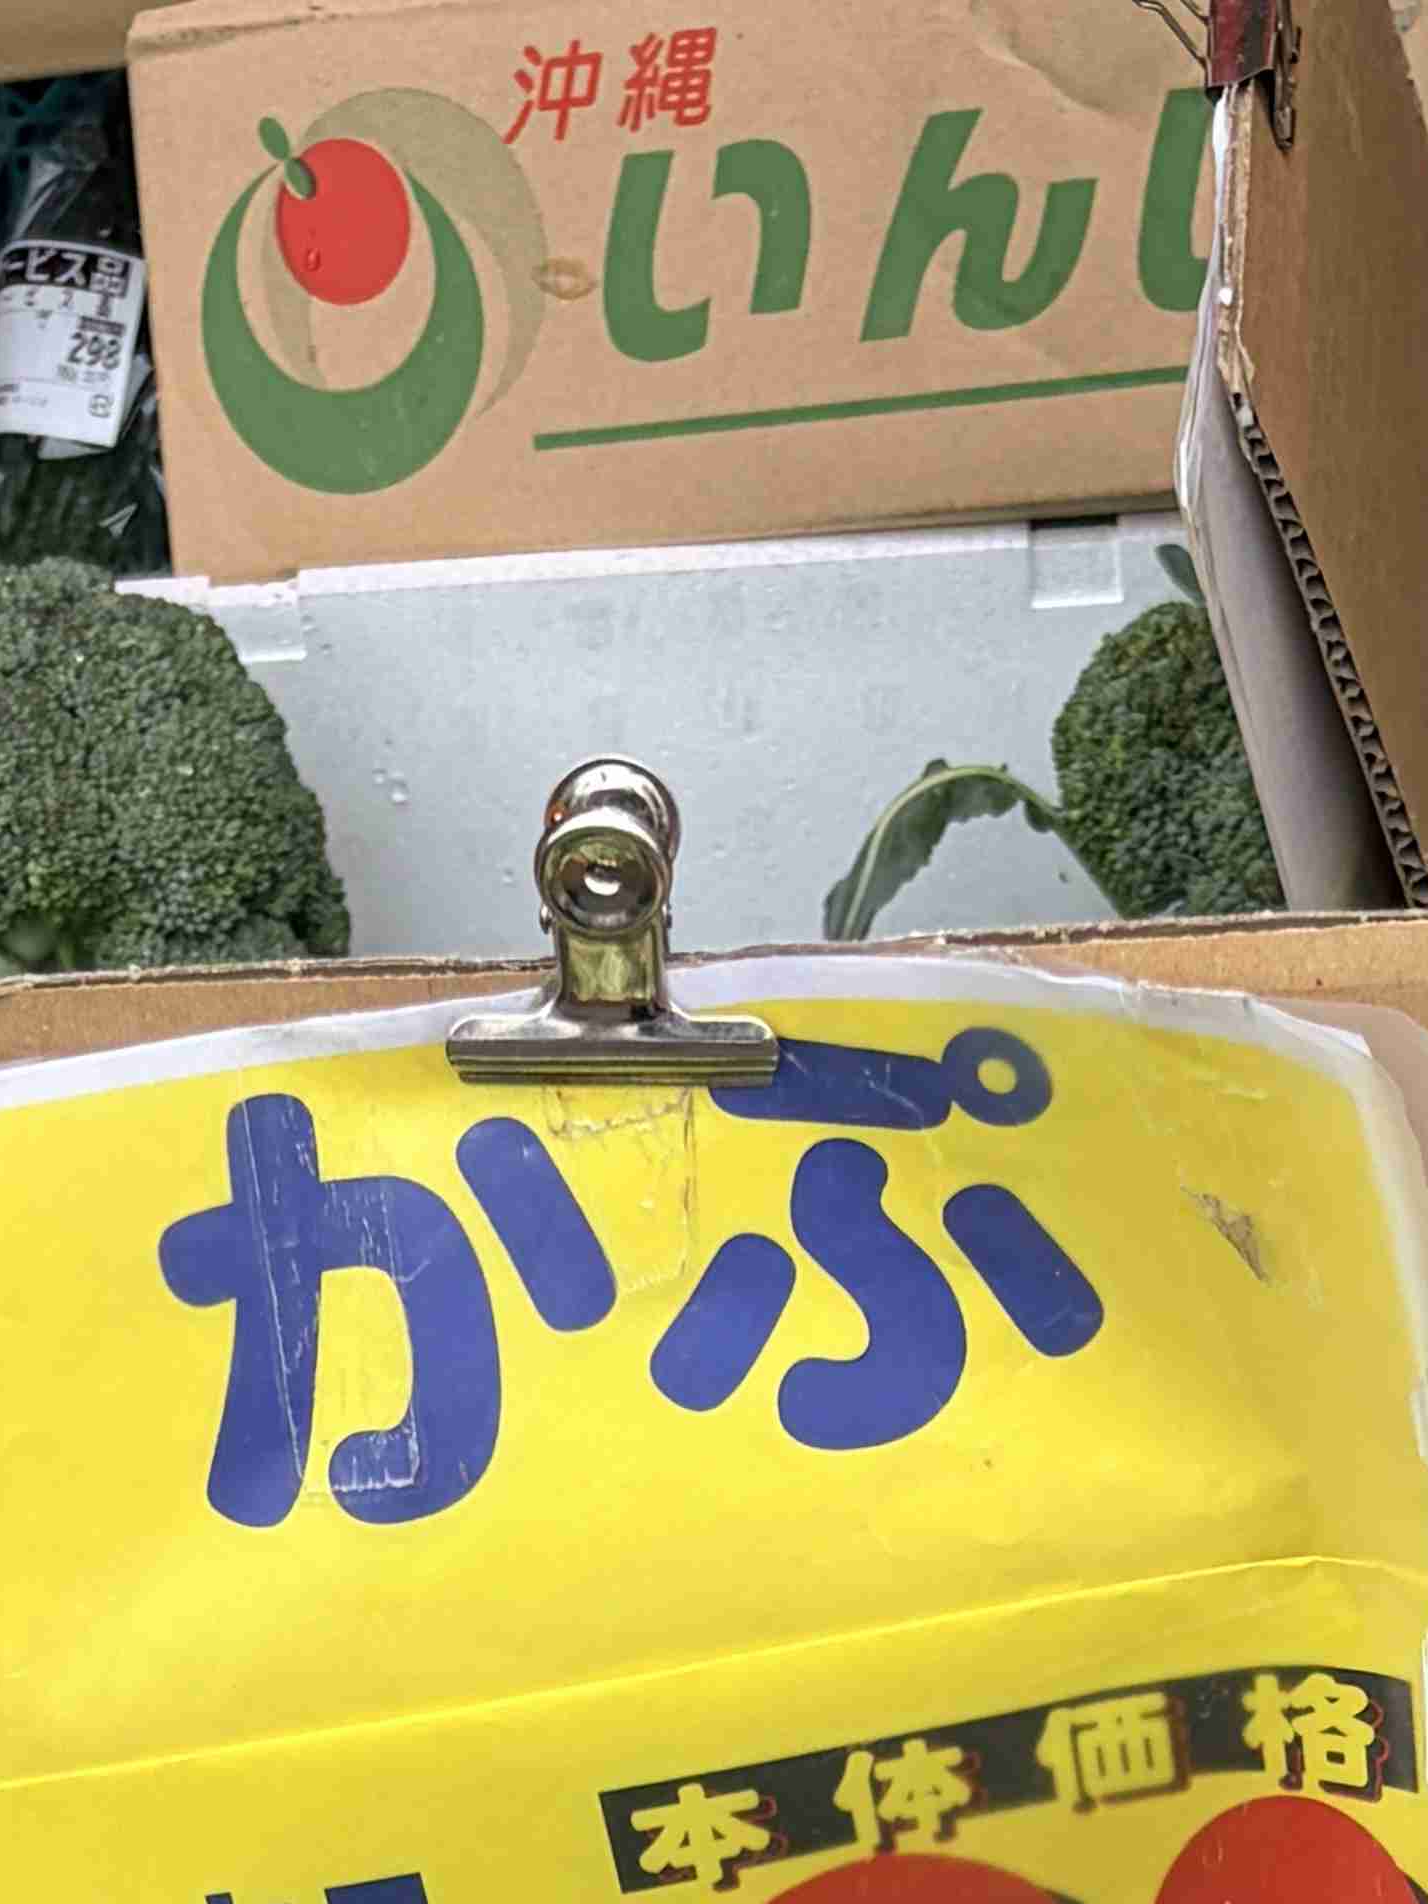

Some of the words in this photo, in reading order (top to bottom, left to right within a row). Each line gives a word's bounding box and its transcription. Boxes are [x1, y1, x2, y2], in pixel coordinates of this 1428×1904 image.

[502, 26, 718, 145] 沖縄
[628, 1670, 1390, 1893] 本体価格
